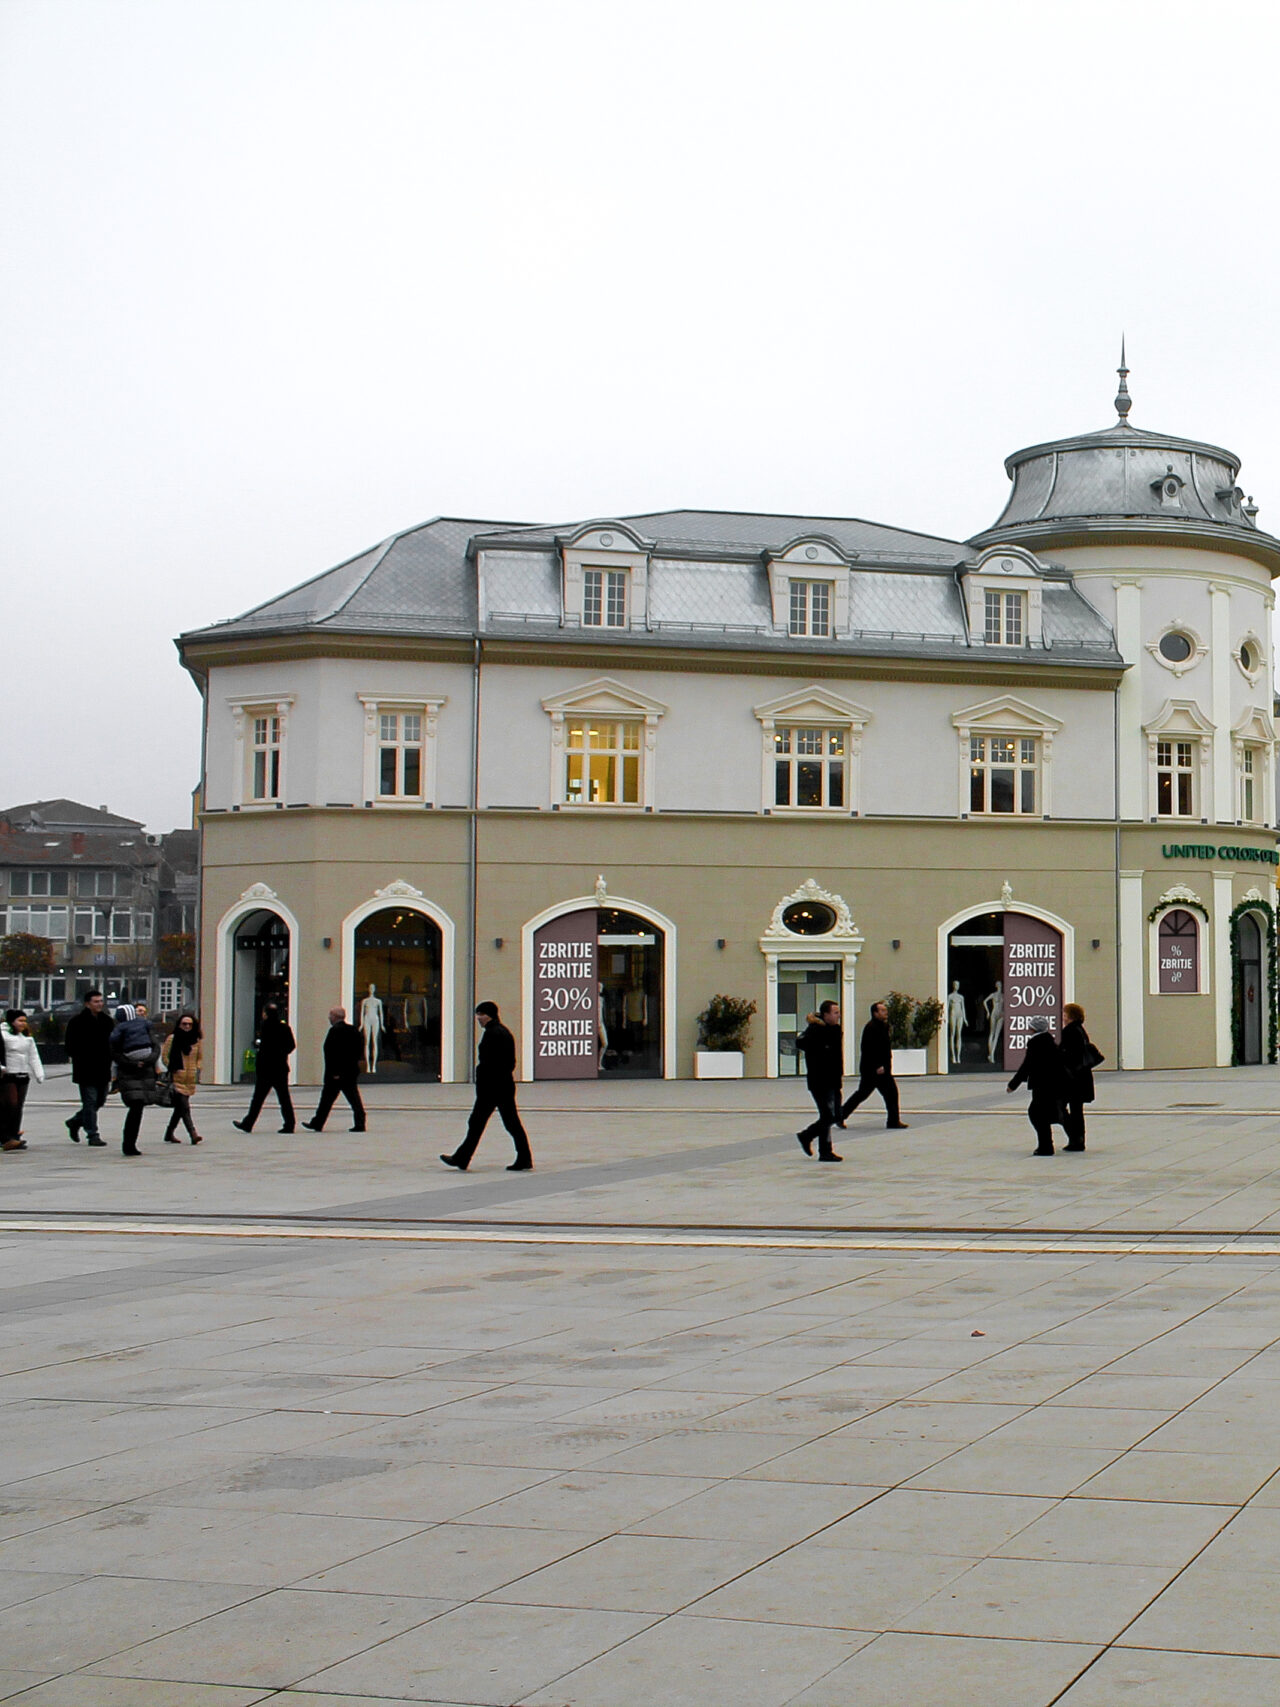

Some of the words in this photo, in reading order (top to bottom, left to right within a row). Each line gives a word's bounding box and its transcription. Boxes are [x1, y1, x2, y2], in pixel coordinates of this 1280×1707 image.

[1162, 844, 1216, 859] UNITED
[1217, 845, 1261, 861] COLORS
[539, 943, 593, 959] ZBRITJE
[1009, 944, 1056, 959] ZBRITJE
[538, 963, 592, 979] ZBRITJE
[1008, 962, 1056, 977] ZBRITJE
[1161, 958, 1193, 970] ZBRITJE
[540, 987, 592, 1012] 30%
[1009, 985, 1056, 1008] 30%
[539, 1020, 593, 1036] ZBRITJE
[1009, 1016, 1057, 1031] ZBRE
[539, 1040, 593, 1057] ZBRITJE
